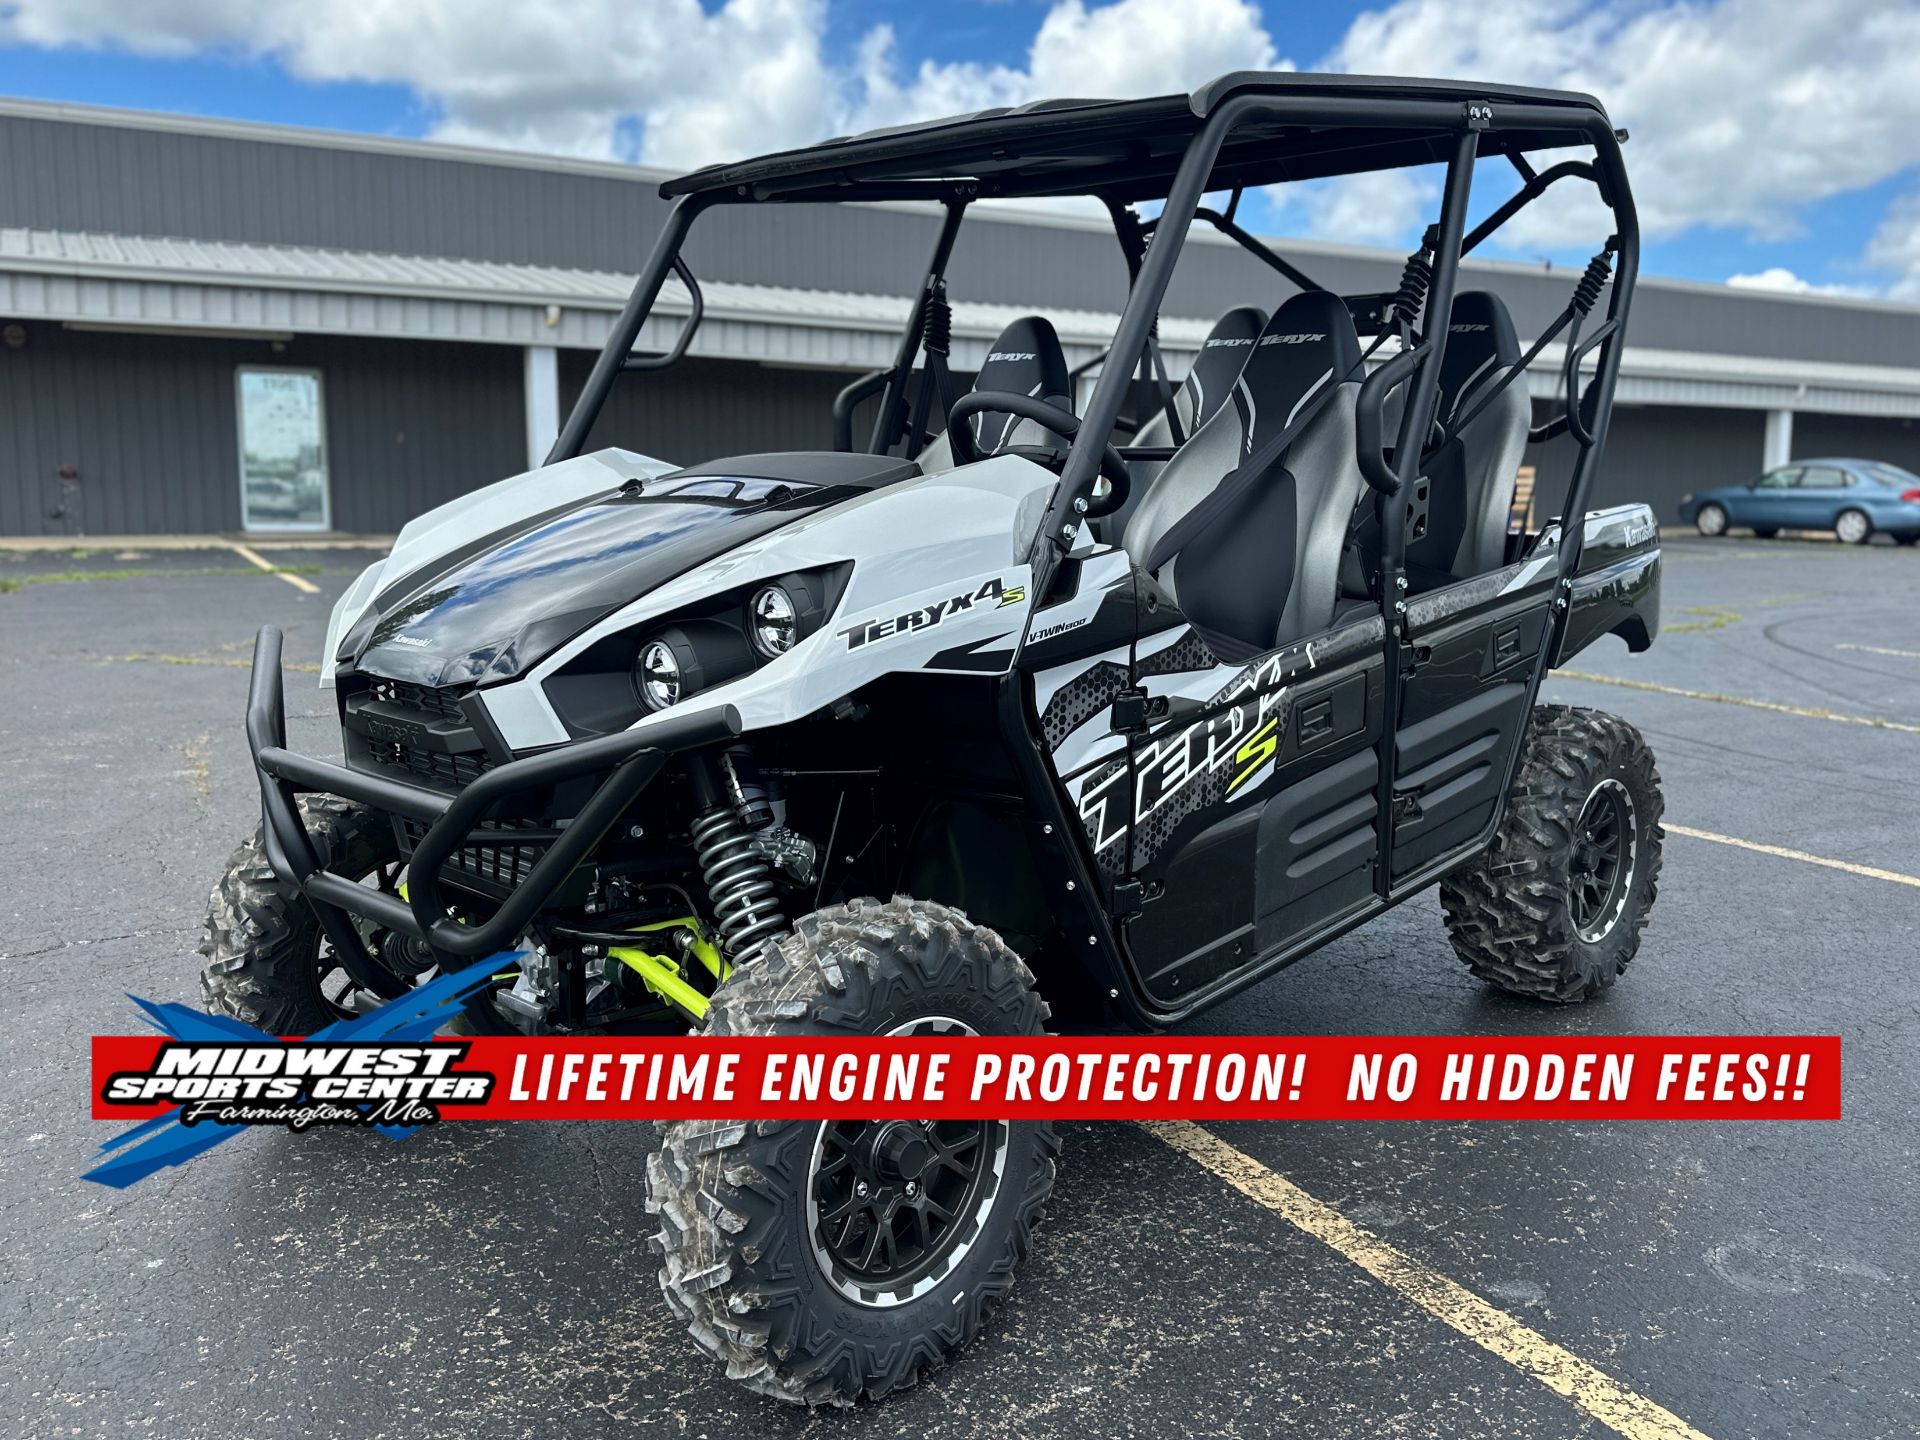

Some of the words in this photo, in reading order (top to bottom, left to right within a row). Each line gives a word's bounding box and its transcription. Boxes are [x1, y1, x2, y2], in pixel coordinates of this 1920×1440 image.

[1206, 338, 1255, 348] TERYX
[1258, 333, 1327, 347] TERYX
[988, 351, 1036, 362] TERYX
[392, 633, 433, 647] Kawasaki
